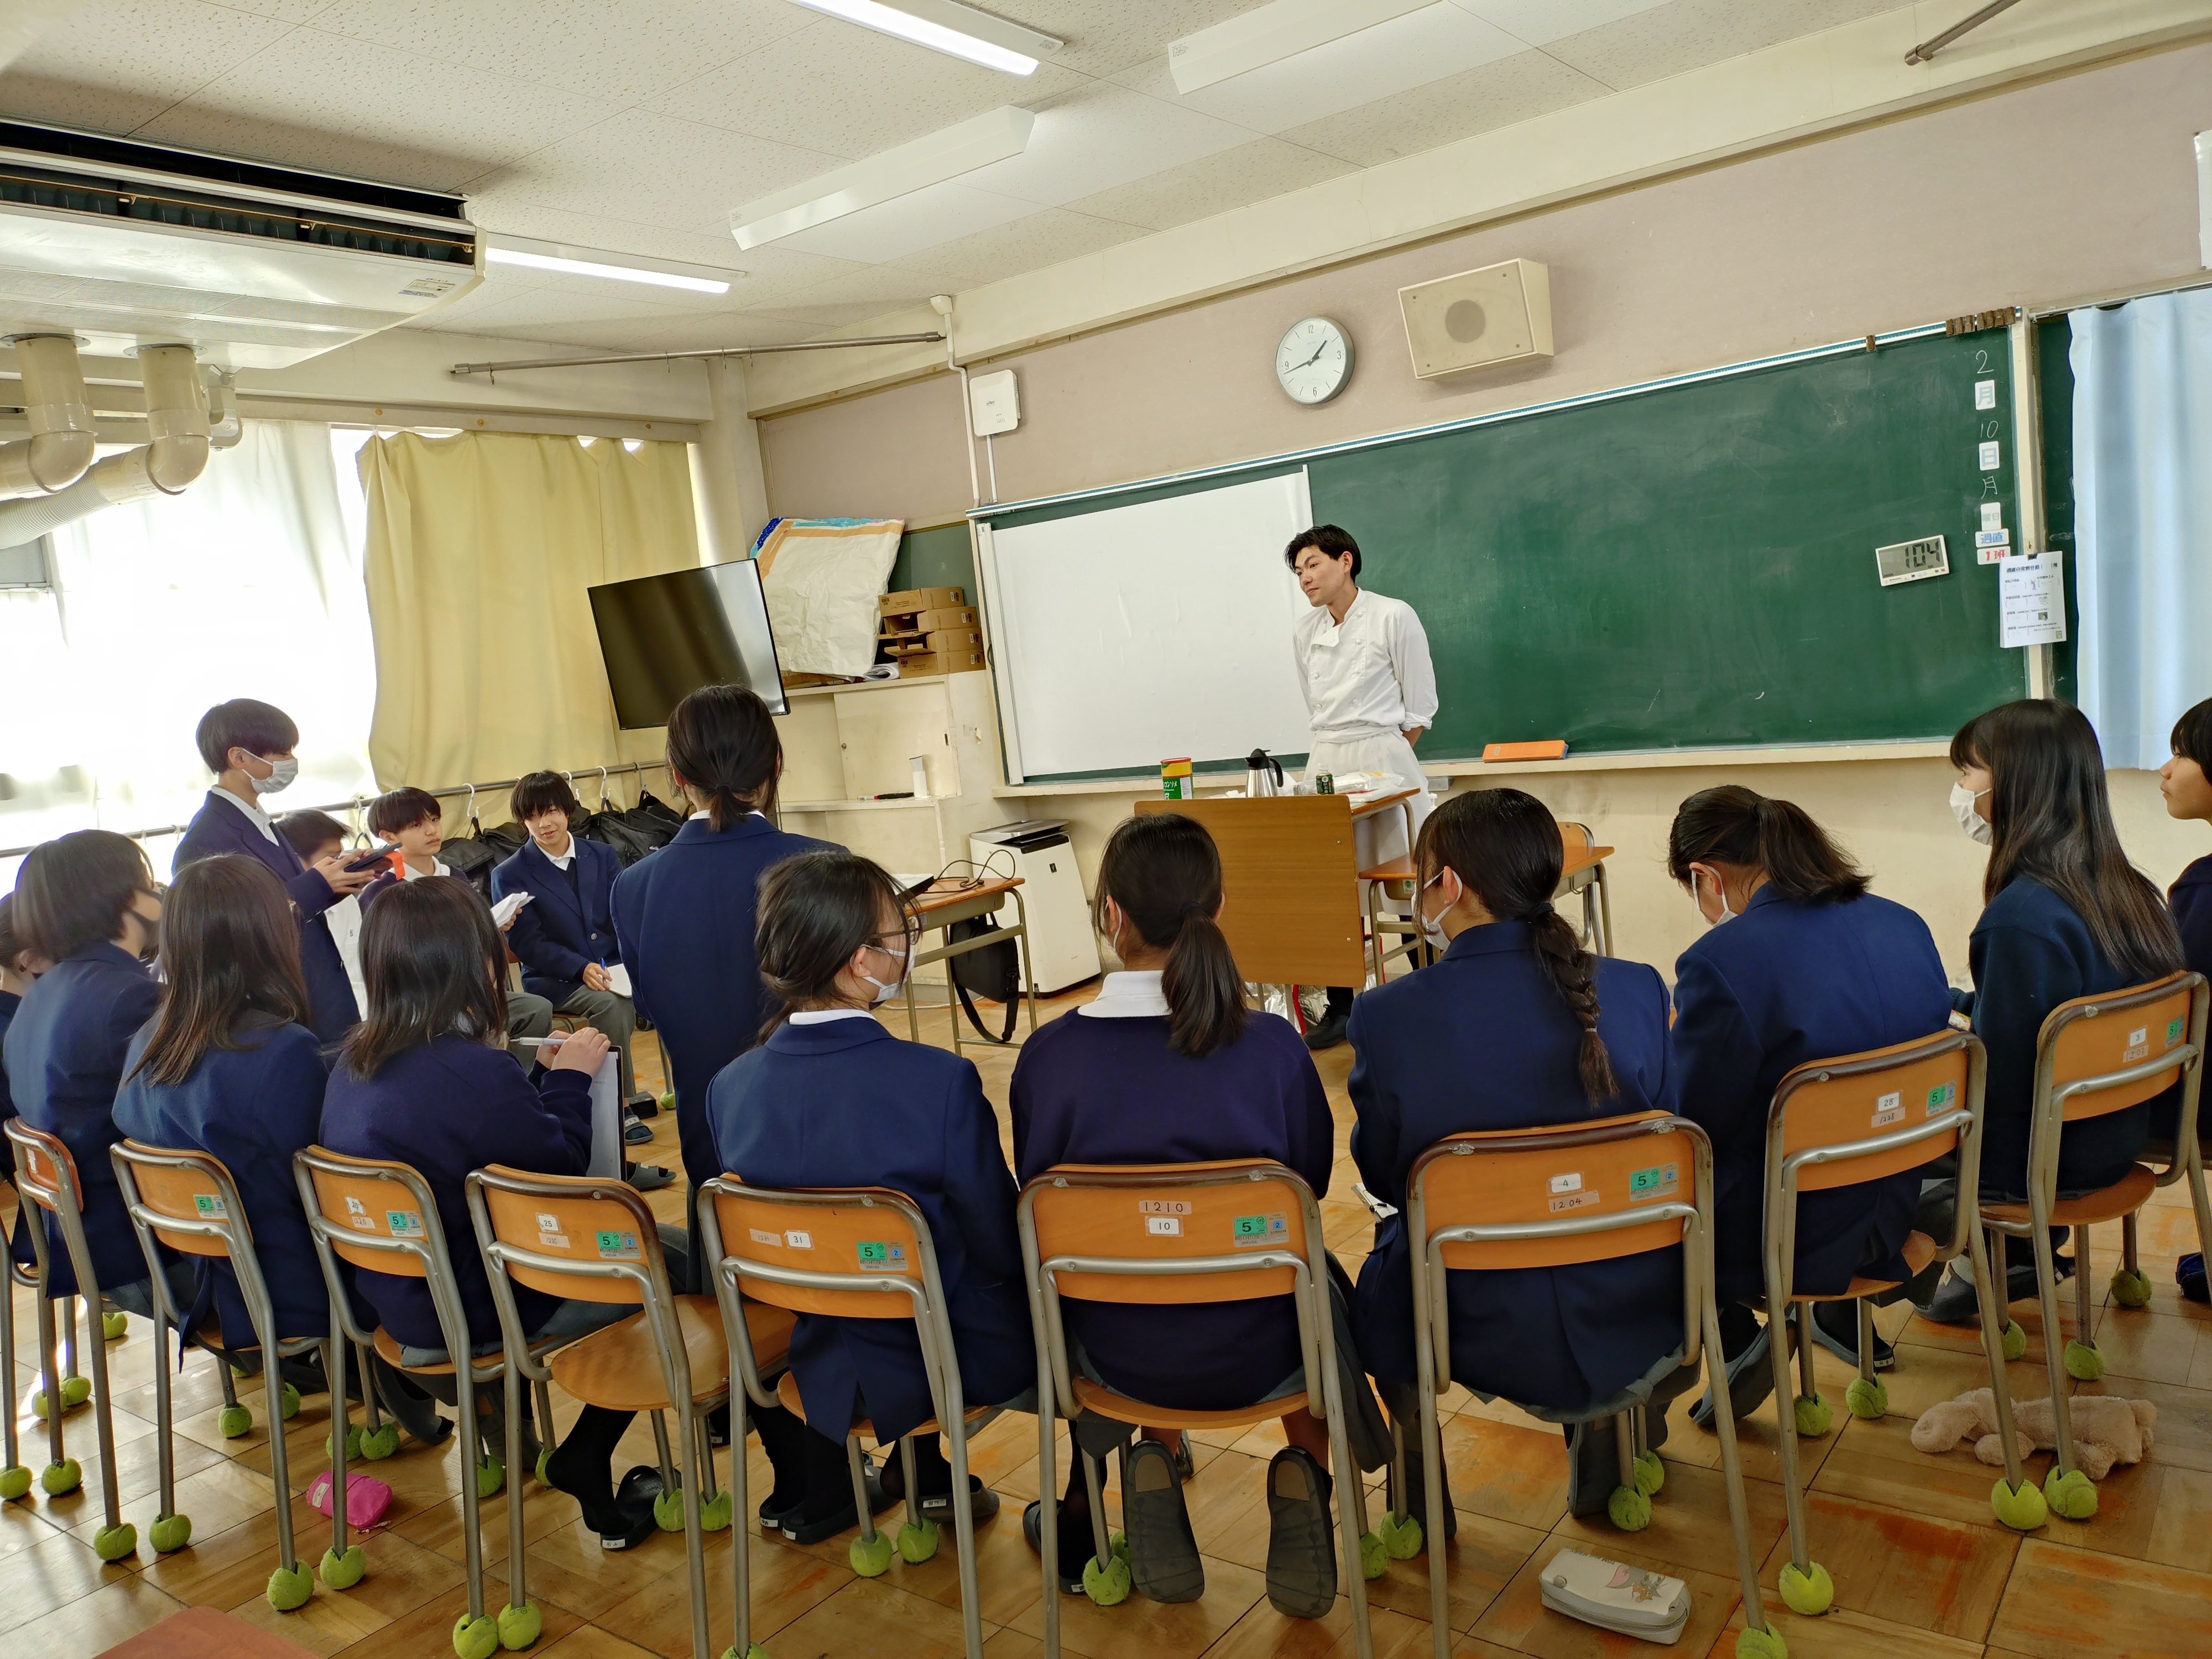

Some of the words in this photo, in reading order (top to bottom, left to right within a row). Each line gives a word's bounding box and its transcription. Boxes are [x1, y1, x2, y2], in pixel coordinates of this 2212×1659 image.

[1308, 325, 1313, 333] 12
[1337, 350, 1341, 359] 3
[1285, 361, 1289, 370] 9
[1976, 350, 1994, 374] 2
[1313, 387, 1317, 396] 6
[1977, 386, 1993, 406] 月
[1980, 421, 1999, 438] 10
[1982, 447, 1997, 467] 日
[1981, 476, 1997, 499] 月
[1982, 513, 2000, 522] 曜日
[1981, 532, 2004, 544] 週直
[1932, 1092, 1938, 1102] 5
[1884, 1098, 1893, 1107] 28
[1638, 1175, 1647, 1186] 5
[1146, 1202, 1183, 1212] 1210
[1553, 1198, 1582, 1210] 1204
[393, 1216, 399, 1224] 5
[1242, 1222, 1251, 1232] 5
[603, 1236, 611, 1245] 5
[864, 1247, 873, 1257] 5
